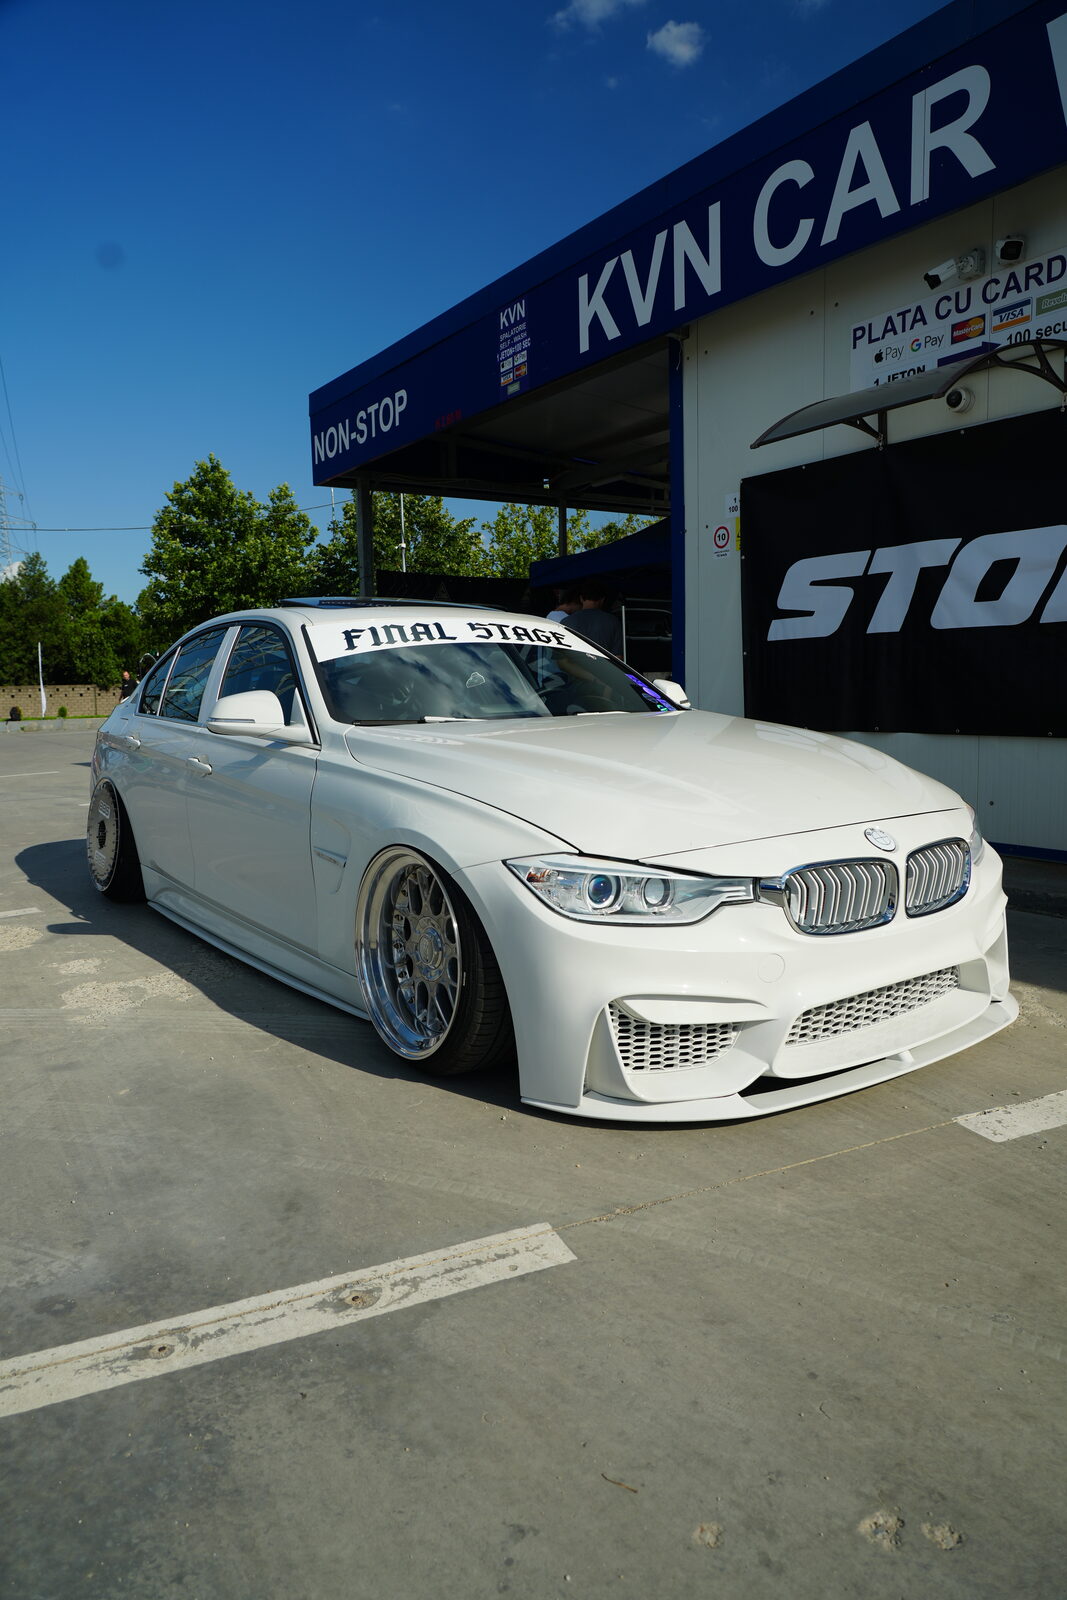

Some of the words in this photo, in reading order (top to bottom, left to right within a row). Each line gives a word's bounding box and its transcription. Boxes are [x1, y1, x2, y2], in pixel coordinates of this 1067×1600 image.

[578, 201, 722, 354] KVN
[753, 64, 997, 267] CAR
[500, 300, 525, 329] KVN
[852, 305, 928, 350] PLATA
[935, 287, 972, 321] CU
[981, 254, 1067, 305] CARD
[999, 307, 1025, 323] VISA
[924, 334, 945, 348] Pay
[1006, 328, 1031, 345] 100
[885, 345, 905, 361] Pay
[314, 388, 408, 465] NON-STOP
[717, 533, 726, 541] 10
[767, 525, 1067, 641] STO
[341, 622, 457, 651] FINAL
[466, 622, 572, 648] STAGE
